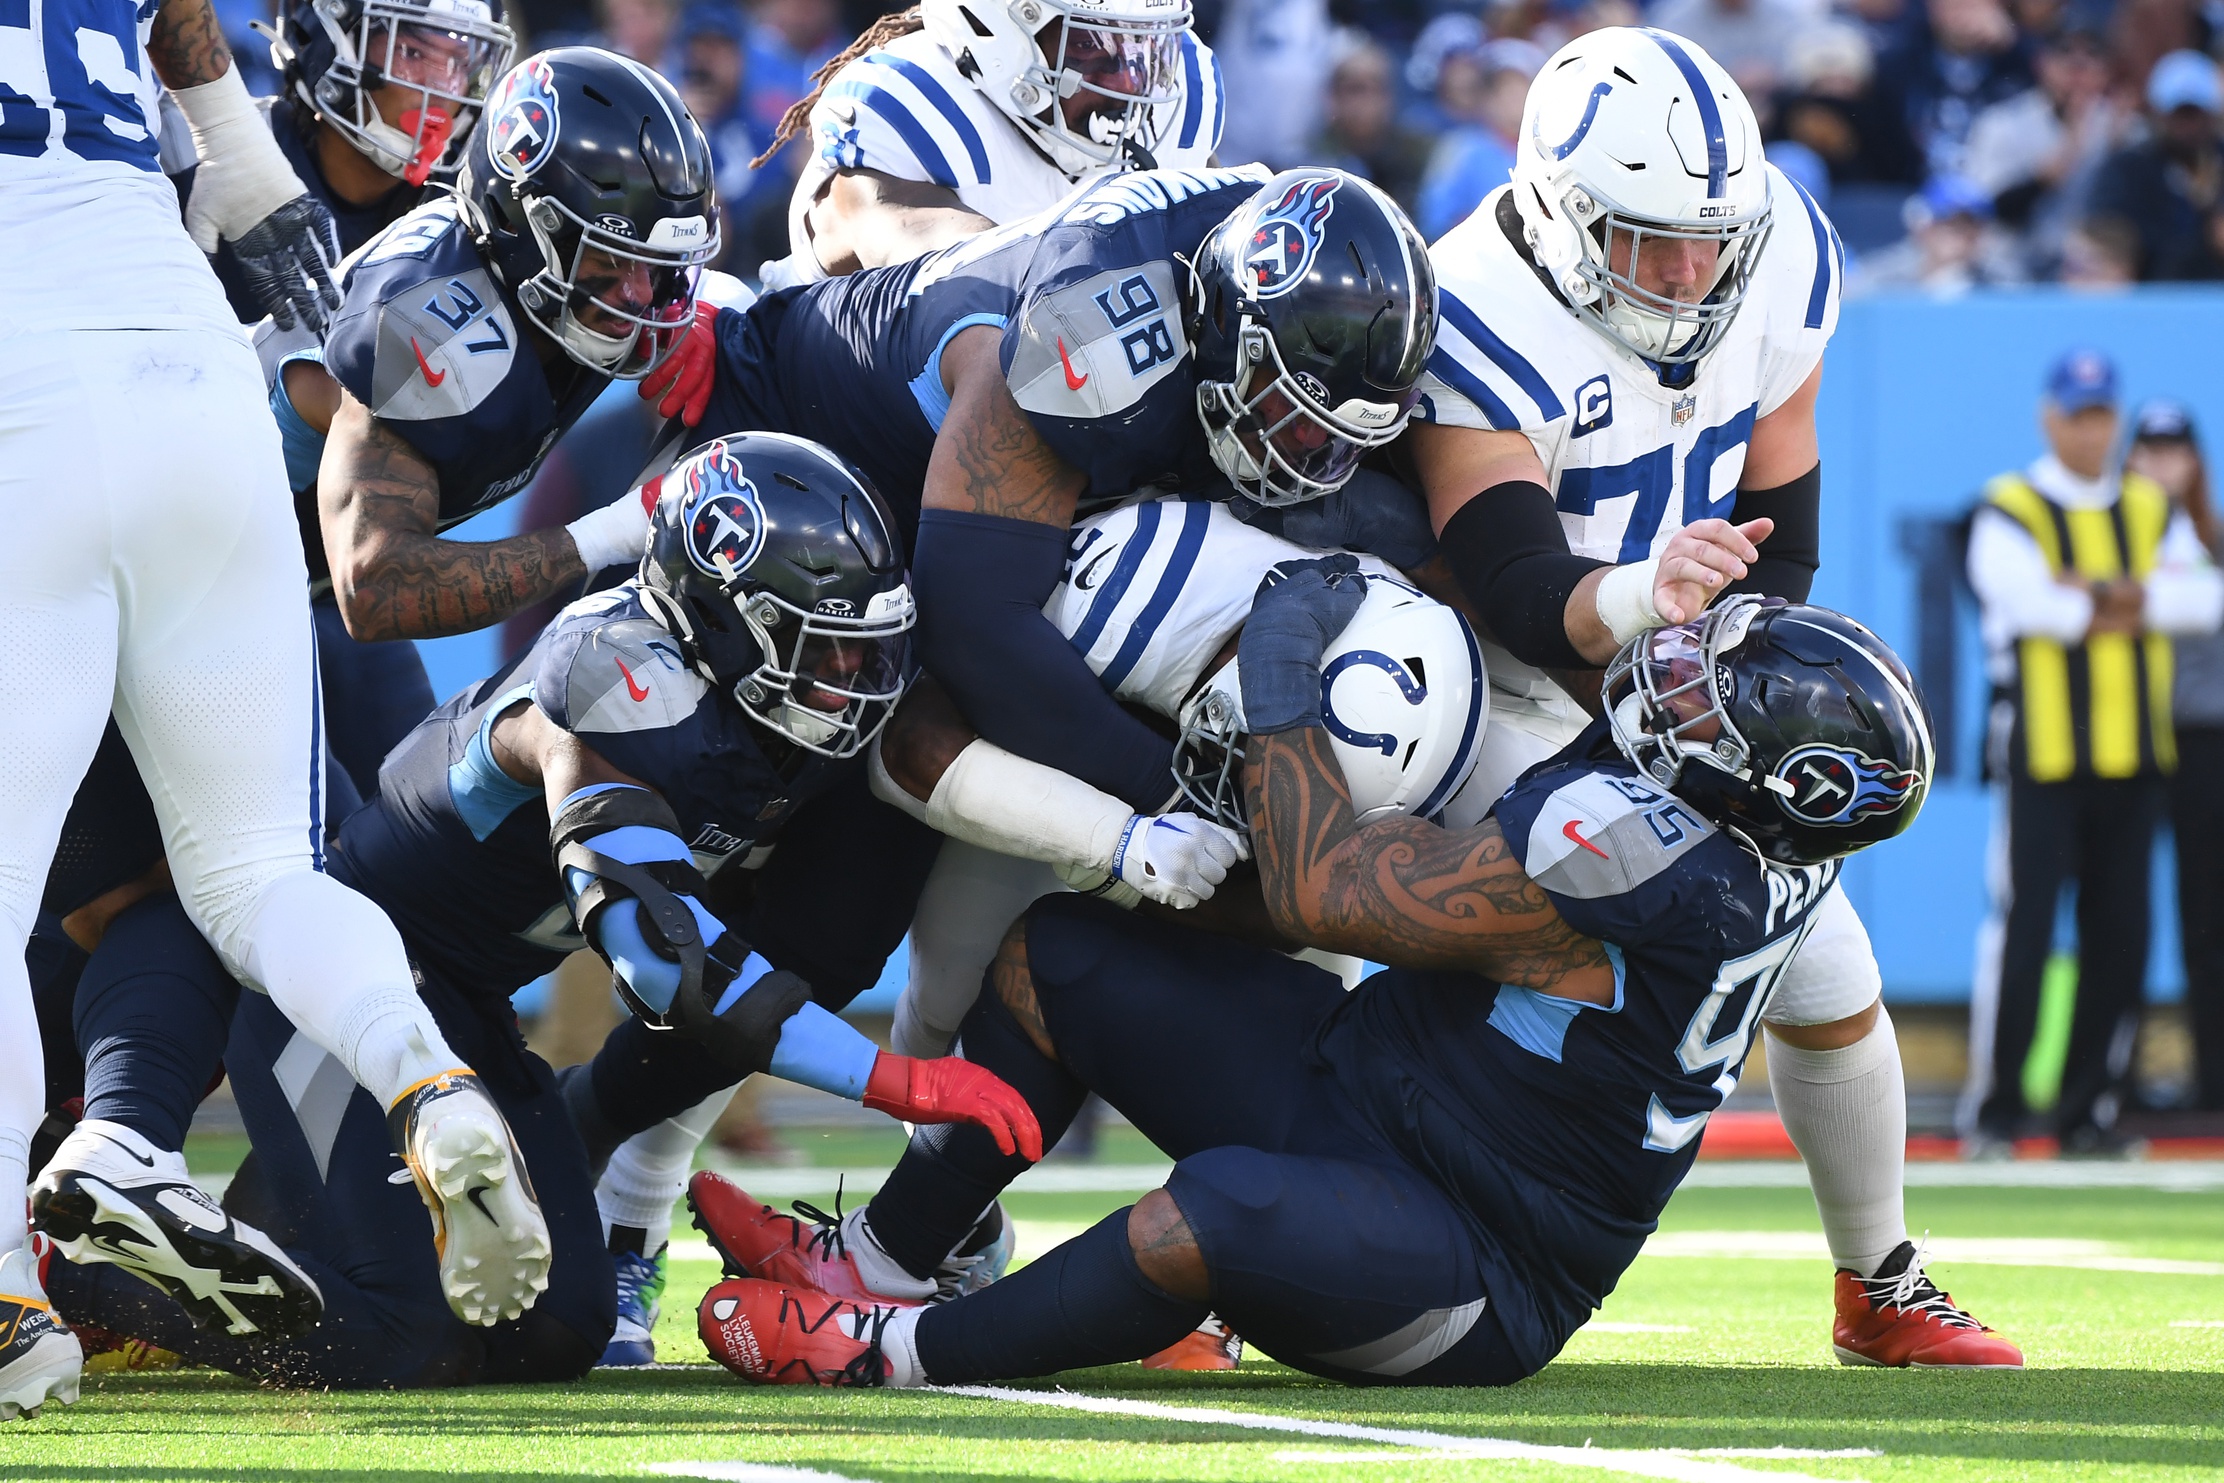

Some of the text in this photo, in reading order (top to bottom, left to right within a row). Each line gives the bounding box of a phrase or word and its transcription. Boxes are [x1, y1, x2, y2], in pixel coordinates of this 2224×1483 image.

[1072, 3, 1110, 12] OAKLEY
[1699, 205, 1736, 218] COLTS
[594, 221, 633, 237] OAKLEY
[672, 223, 699, 238] TITANS
[421, 278, 511, 355] 37
[1091, 272, 1176, 380] 98
[1297, 375, 1325, 405] OAKLEY
[1578, 380, 1609, 426] C
[1358, 407, 1390, 420] TITANS
[1675, 408, 1693, 422] NFL
[818, 606, 856, 618] OAKLEY
[884, 592, 904, 612] TITANS
[1717, 667, 1727, 705] OAKLEY
[15, 1337, 30, 1348] The
[720, 1323, 741, 1366] SOCIETY
[729, 1318, 755, 1375] LYMPHOMA
[738, 1313, 763, 1366] LEUKEMIA
